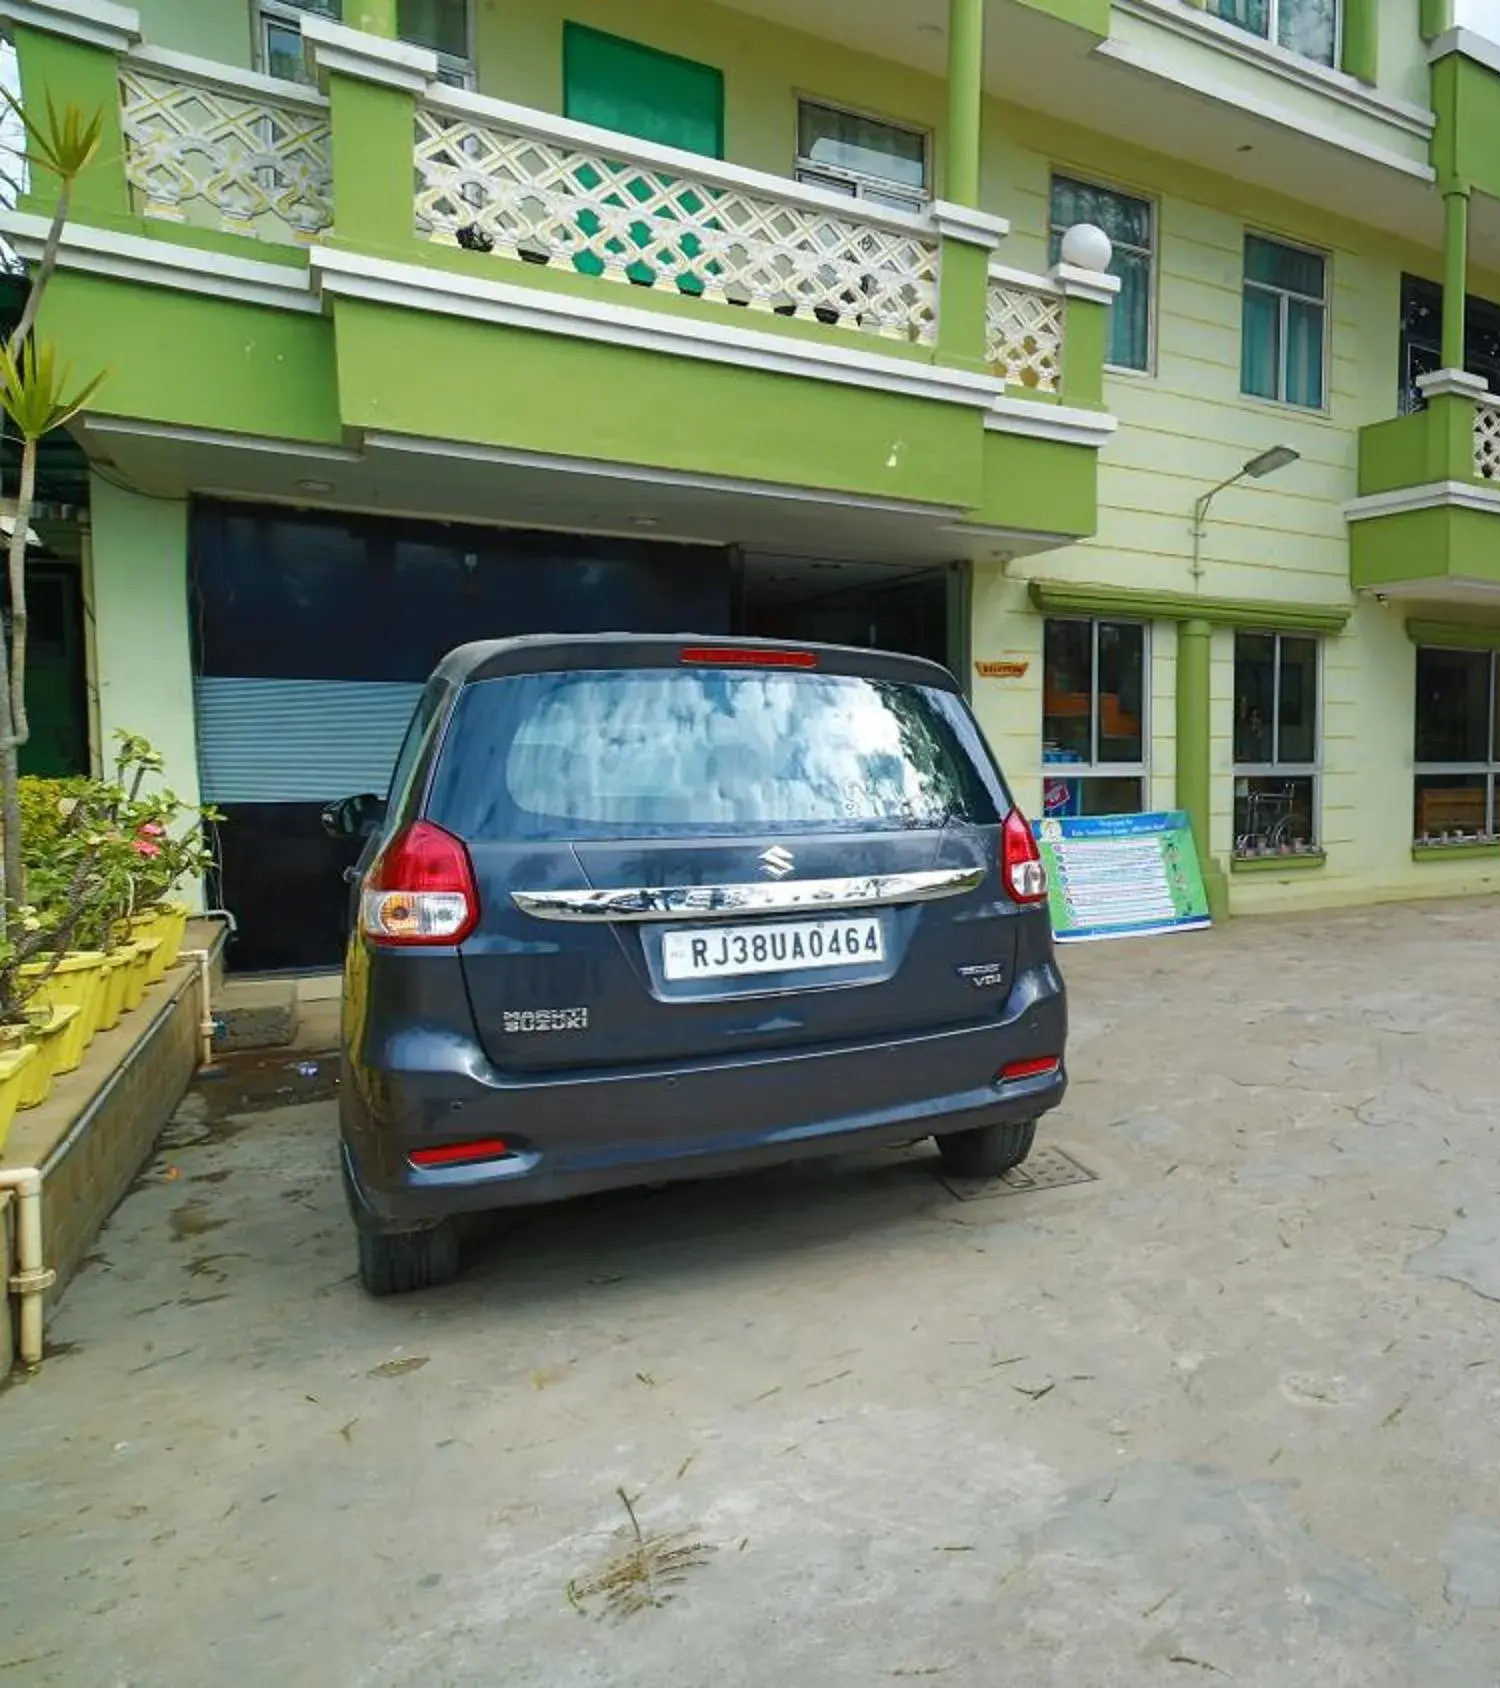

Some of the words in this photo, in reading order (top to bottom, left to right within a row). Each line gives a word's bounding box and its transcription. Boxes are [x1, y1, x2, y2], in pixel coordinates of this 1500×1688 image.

[691, 925, 877, 968] RJ38UA0464
[503, 1007, 588, 1021] MARUTI
[503, 1016, 588, 1033] SUZUKI
